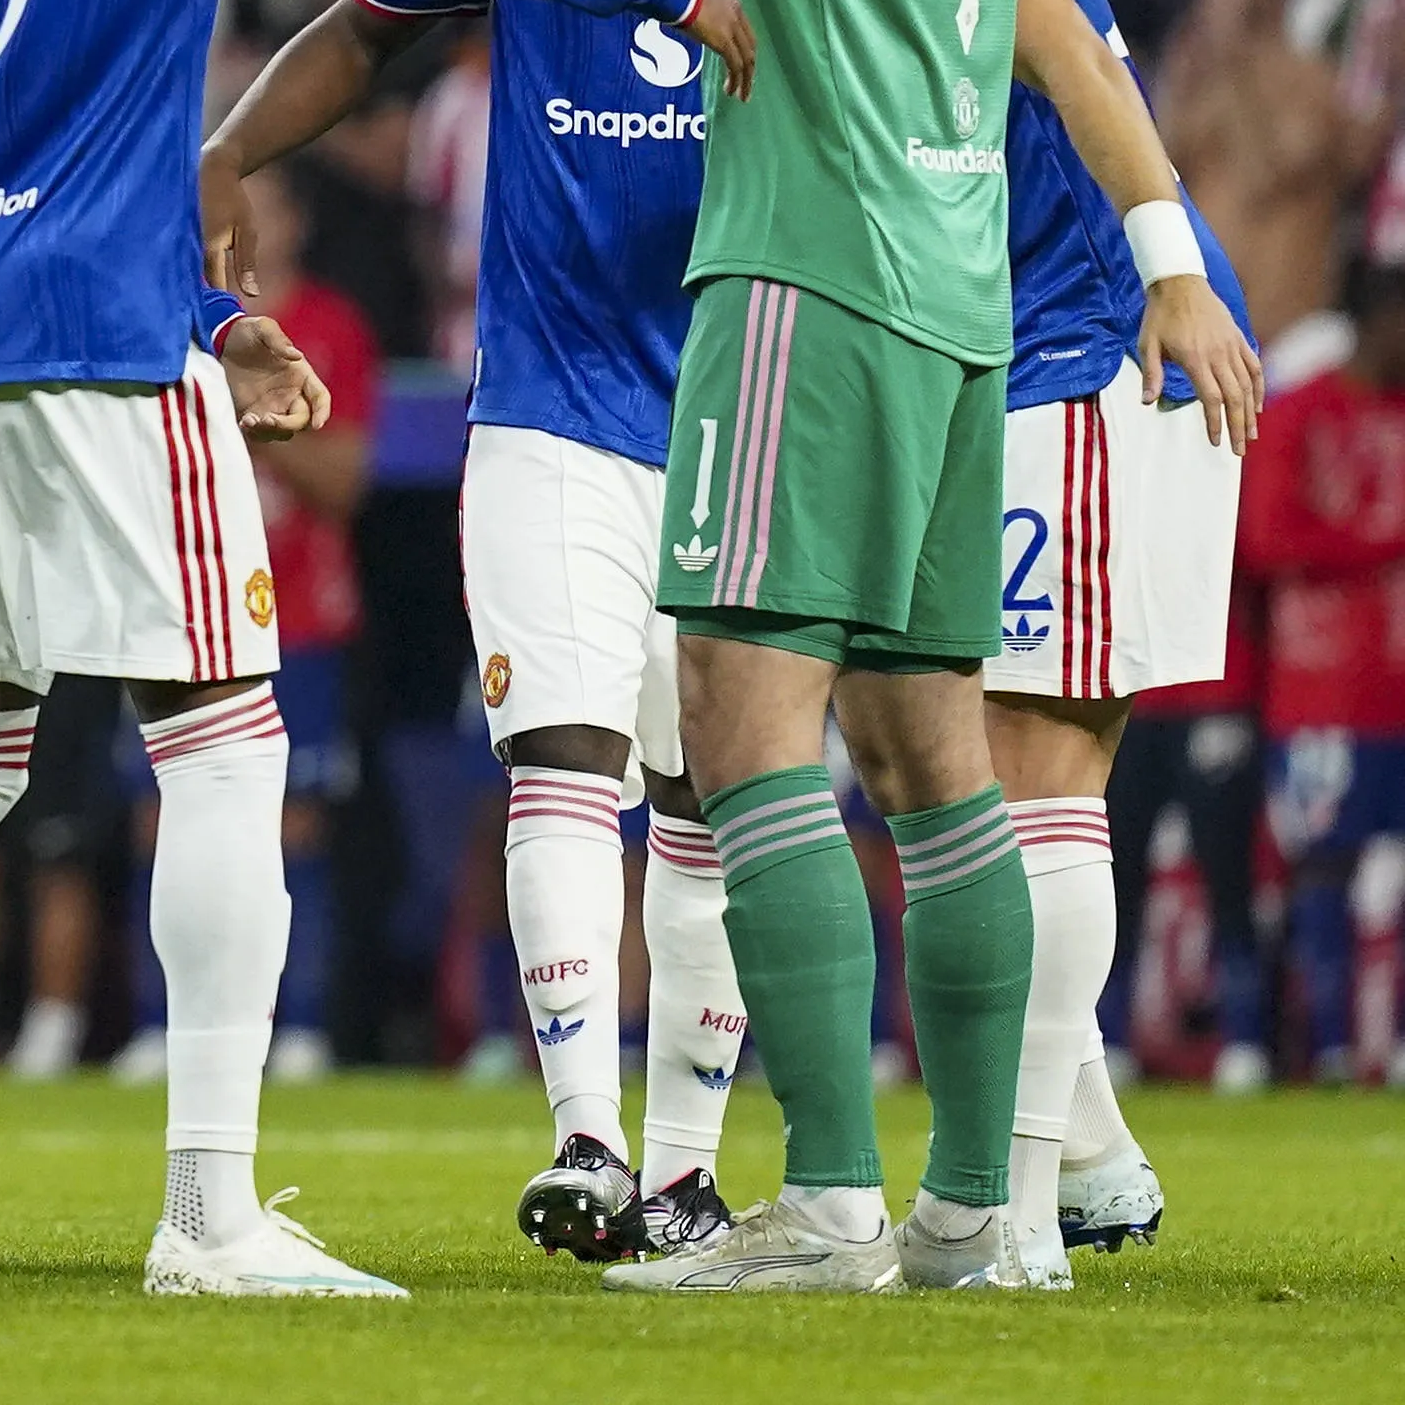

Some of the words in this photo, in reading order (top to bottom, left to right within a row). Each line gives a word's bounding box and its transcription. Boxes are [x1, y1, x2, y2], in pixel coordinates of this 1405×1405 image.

[690, 418, 718, 529] 1
[1002, 507, 1054, 611] 2
[523, 959, 589, 986] MUFC
